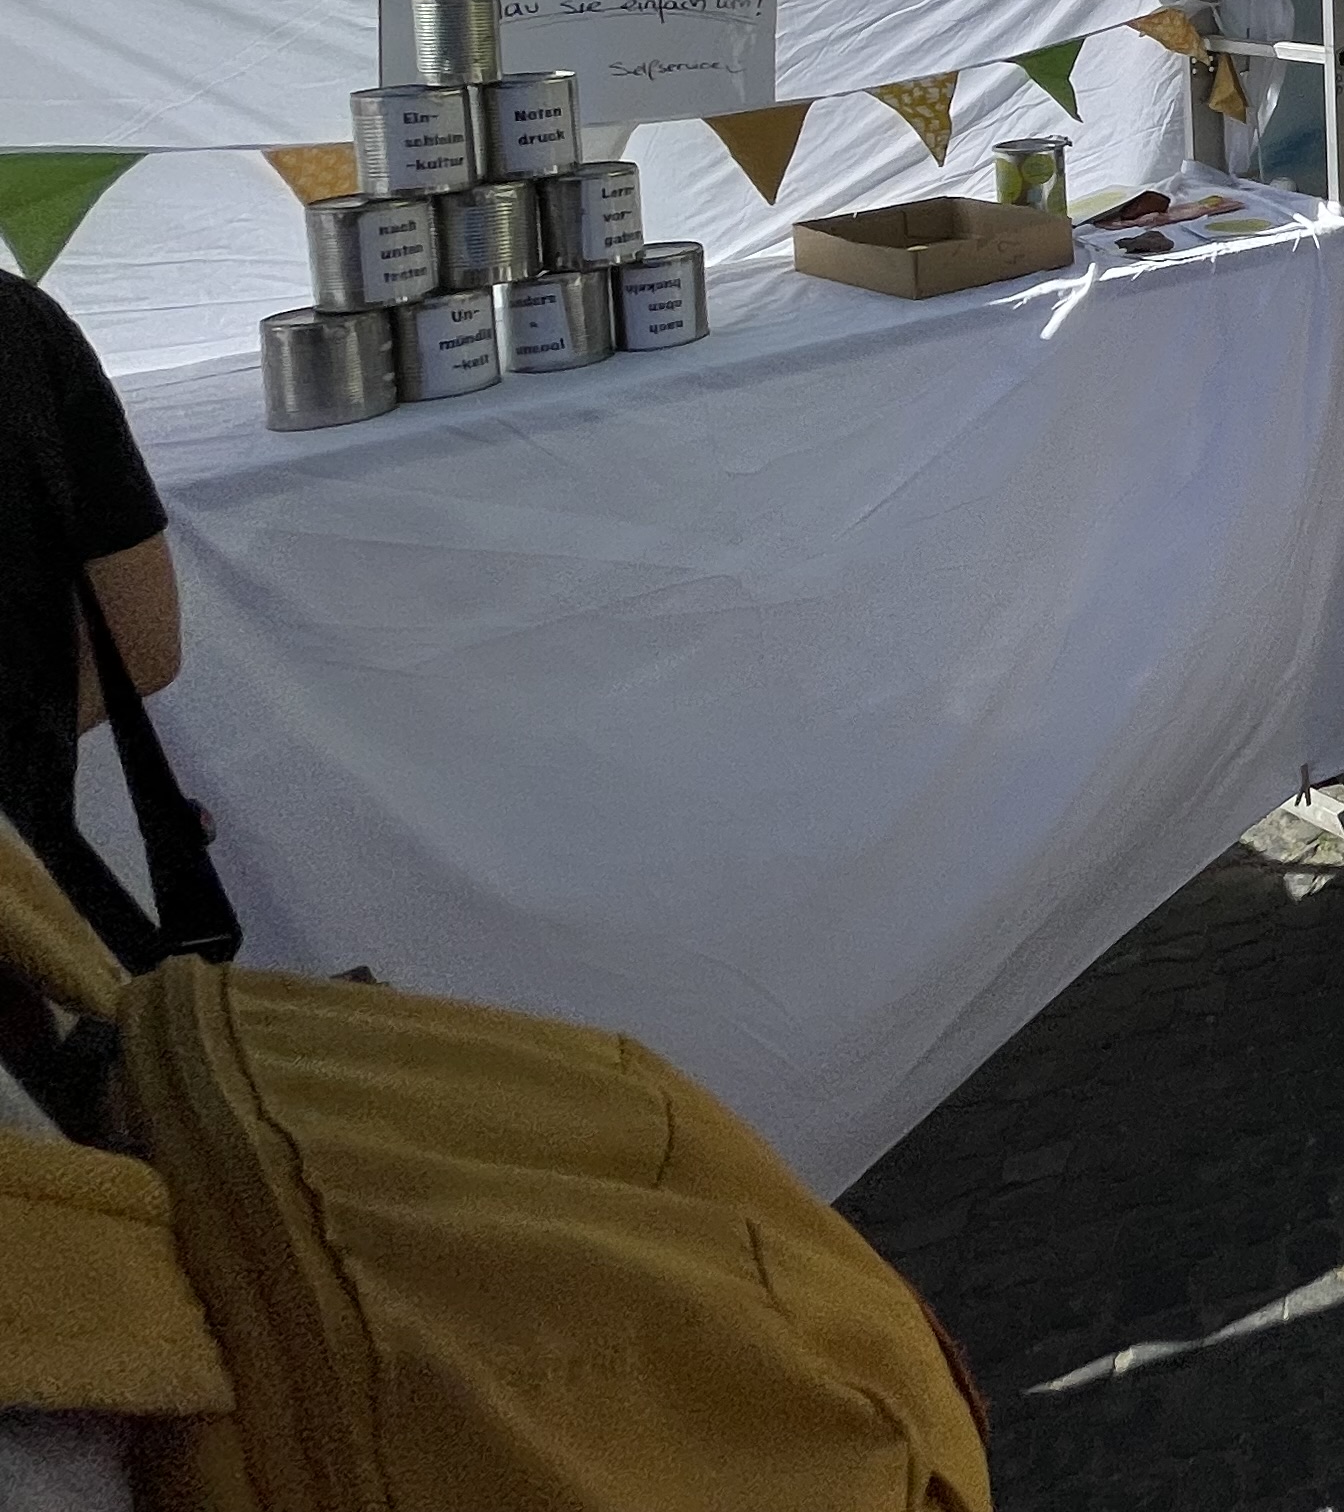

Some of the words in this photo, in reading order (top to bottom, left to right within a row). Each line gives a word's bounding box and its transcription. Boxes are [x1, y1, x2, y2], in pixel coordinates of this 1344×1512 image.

[514, 107, 561, 123] Noten
[518, 129, 565, 146] druck
[451, 308, 480, 324] Un-
